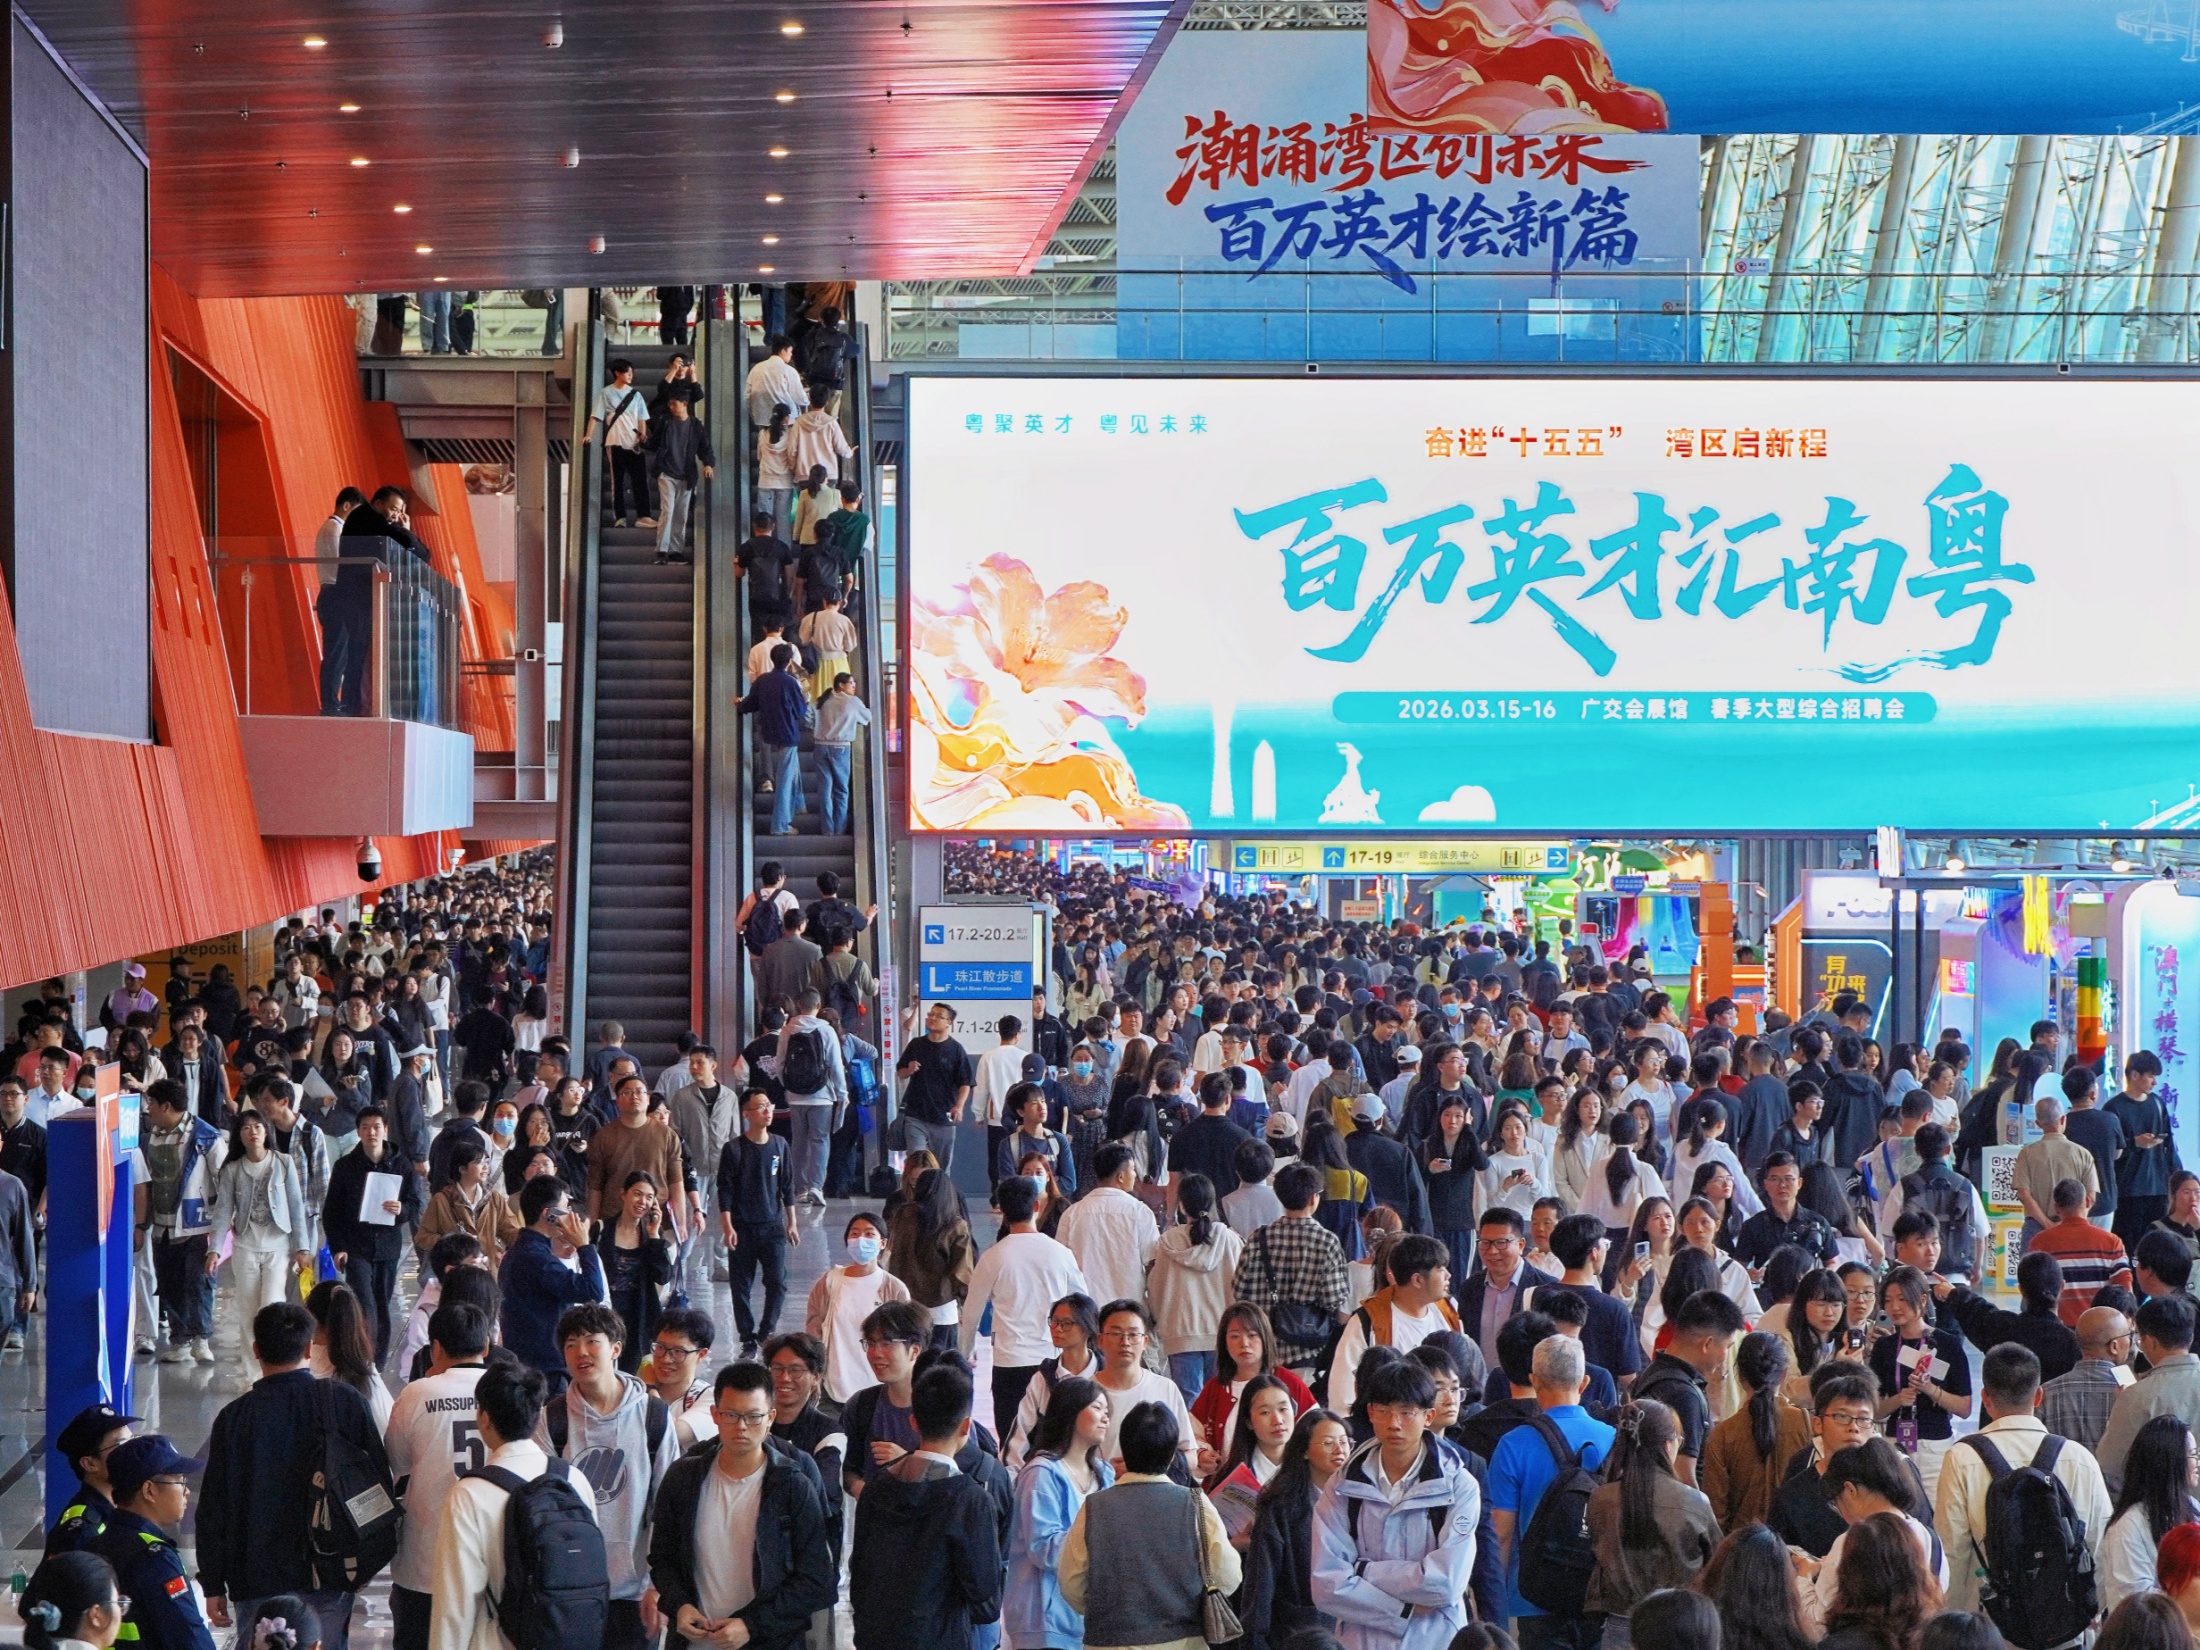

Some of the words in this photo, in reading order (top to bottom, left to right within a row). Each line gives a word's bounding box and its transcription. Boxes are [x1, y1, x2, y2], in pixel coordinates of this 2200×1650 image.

[1166, 110, 1653, 206] 潮涌湾区创未来
[1204, 186, 1638, 298] 百万英才绘新篇
[965, 413, 1074, 434] 粤聚英才
[1100, 413, 1208, 434] 粤见未来
[1425, 426, 1623, 458] 奋进“十五五”
[1665, 427, 1828, 459] 湾区启新程
[1233, 463, 2036, 685] 百万英才汇南粤
[1398, 699, 1557, 719] 2026.03.15-16
[1581, 699, 1688, 719] 广交会展馆
[1711, 698, 1905, 719] 春季大型综合招聘会
[1349, 851, 1392, 864] 17-19
[1419, 850, 1479, 860] 综合服务中心
[948, 928, 1015, 941] 17.2-20.2
[955, 969, 1023, 983] 珠江散步道
